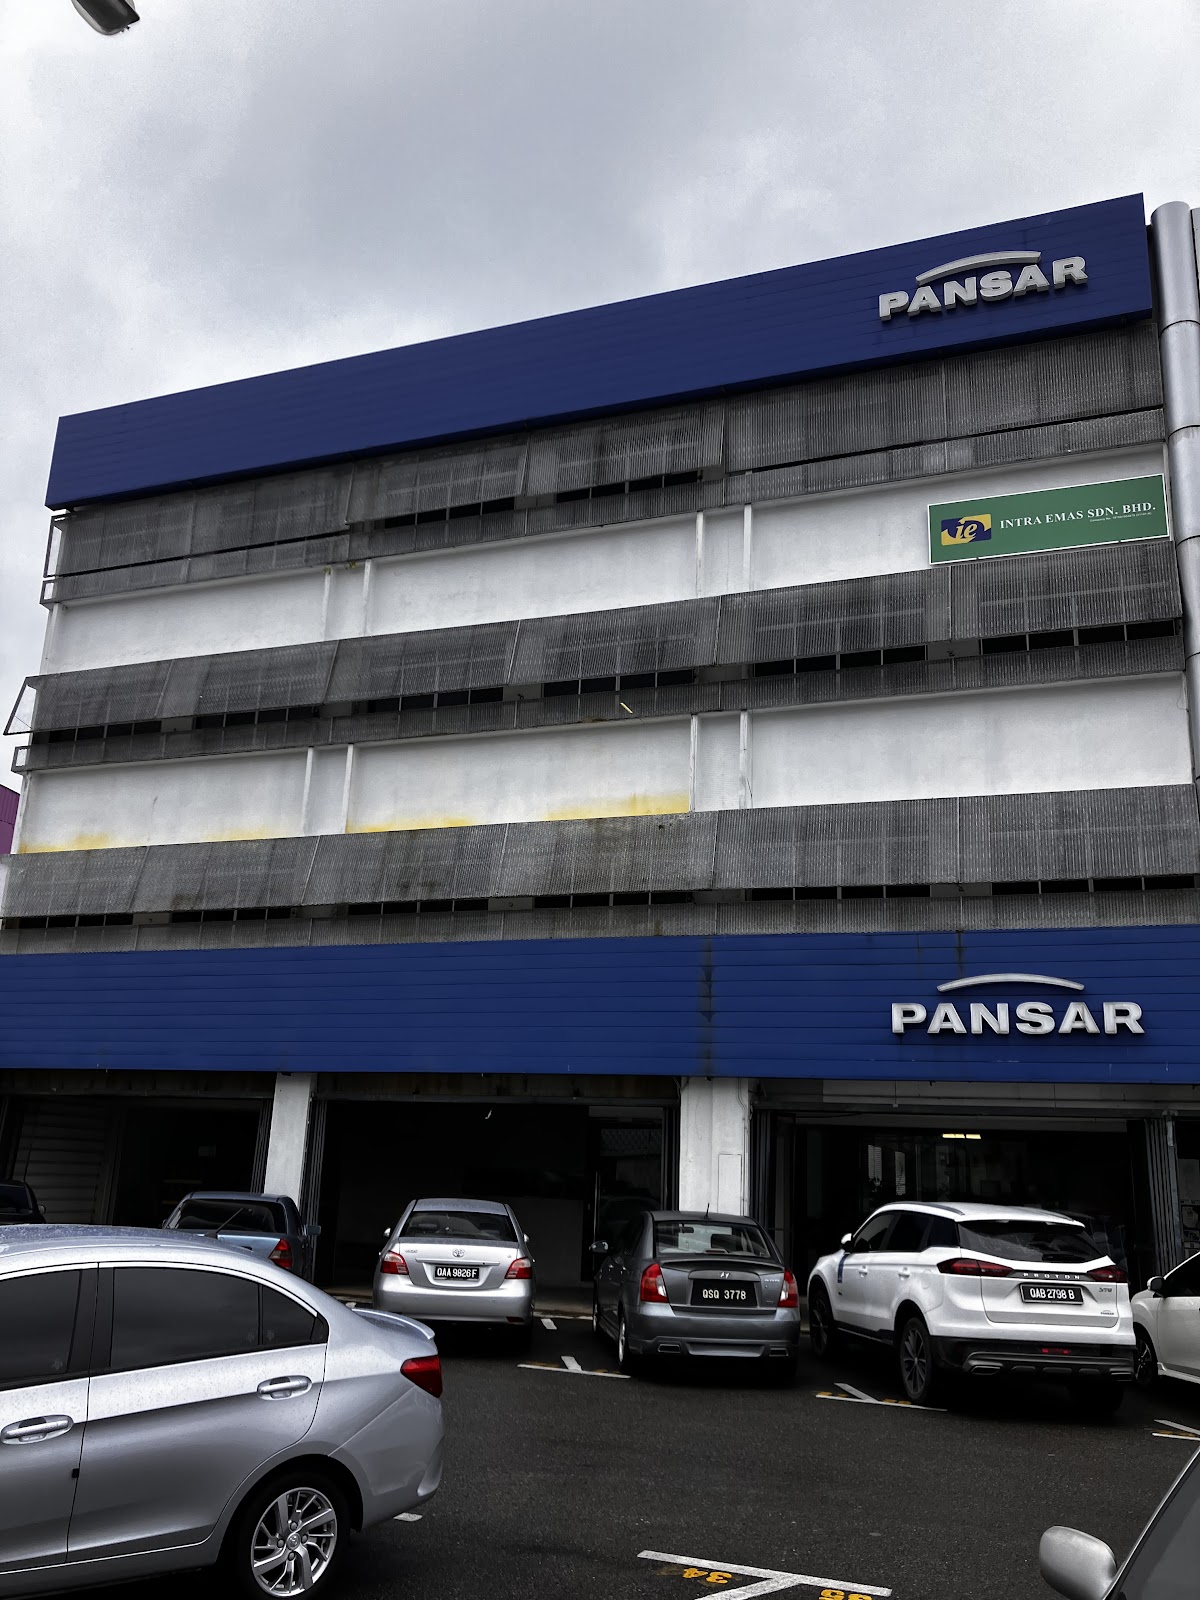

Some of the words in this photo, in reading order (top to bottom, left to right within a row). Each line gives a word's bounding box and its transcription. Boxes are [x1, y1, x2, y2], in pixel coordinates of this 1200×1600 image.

[879, 256, 1088, 321] PANSAR
[1000, 516, 1042, 529] INTRA
[1045, 510, 1084, 523] EMAS
[1087, 507, 1119, 518] SDN.
[1122, 502, 1156, 514] BHD.
[891, 1001, 1145, 1035] PANSAR
[1023, 1272, 1080, 1280] PROTON
[702, 1289, 720, 1299] QSQ
[724, 1290, 747, 1300] 3778
[1047, 1289, 1067, 1299] 2798
[1068, 1290, 1075, 1300] B
[683, 1567, 733, 1584] 34
